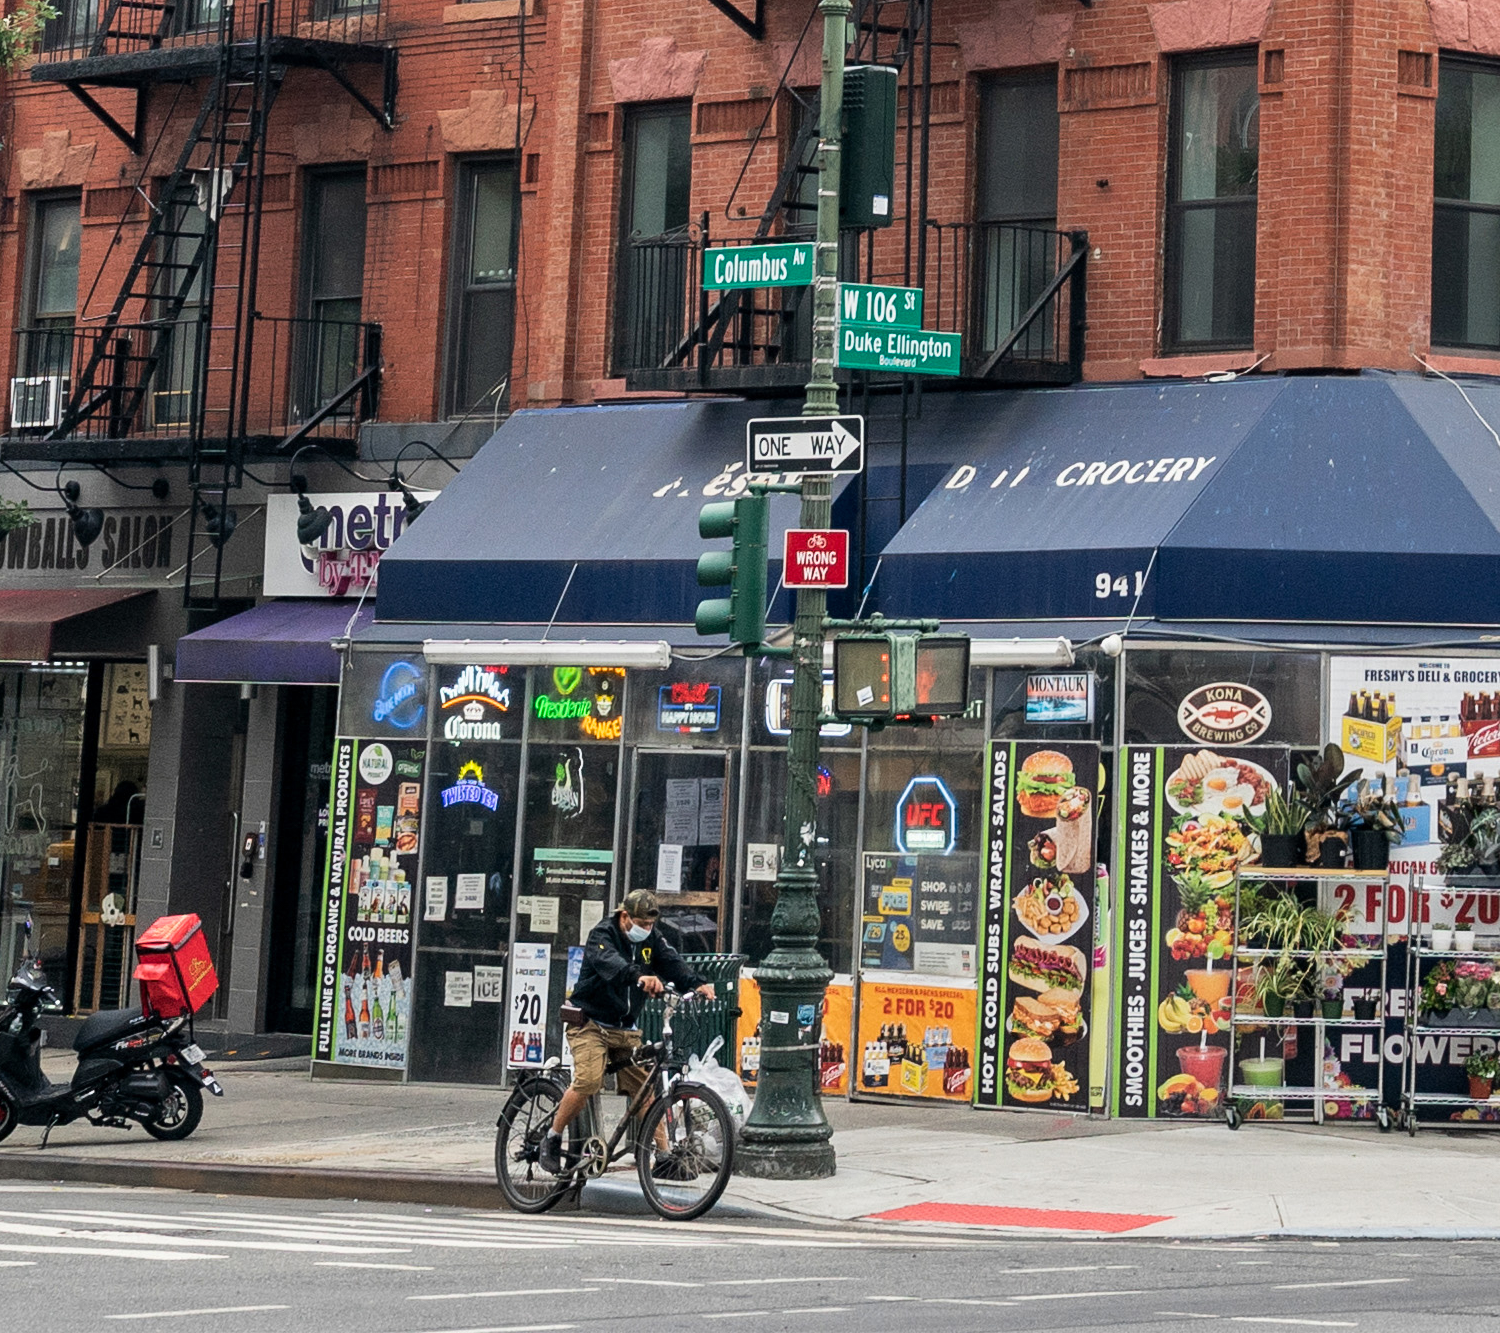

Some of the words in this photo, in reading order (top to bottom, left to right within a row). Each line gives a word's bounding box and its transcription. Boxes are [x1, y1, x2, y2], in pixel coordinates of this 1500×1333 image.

[715, 252, 788, 284] Columbus
[793, 248, 806, 266] Av
[844, 290, 859, 319] W
[866, 292, 897, 323] 106
[904, 291, 915, 310] St
[845, 331, 882, 353] Duke
[887, 334, 952, 362] Ellington
[879, 354, 917, 368] Boulevard
[759, 436, 792, 456] ONE
[811, 435, 846, 455] WAY
[101, 515, 174, 570] SALON
[796, 551, 837, 566] WRONG
[318, 550, 346, 597] by
[803, 567, 829, 581] WAY
[1095, 571, 1143, 598] 941
[1029, 676, 1084, 692] MONTAUK
[1364, 670, 1415, 683] FRESHY'S
[1417, 670, 1439, 683] DELI
[1442, 671, 1451, 683] &
[1206, 687, 1242, 702] KONA
[535, 695, 592, 719] Presidente
[661, 711, 689, 724] HAPPY
[689, 711, 716, 724] HOUR
[444, 716, 501, 740] Corona
[1192, 721, 1244, 744] BREWING
[361, 758, 389, 770] NATURAL
[1421, 747, 1455, 759] Corona
[336, 744, 350, 821] PRODUCTS
[993, 750, 1007, 826] SALADS
[1133, 752, 1151, 806] MORE
[441, 785, 480, 808] TWISTED
[480, 789, 499, 812] TEA
[906, 804, 945, 826] UFC
[1132, 813, 1148, 826] &
[330, 823, 345, 883] NATURAL
[866, 856, 887, 869] Lyca
[989, 840, 1003, 910] WRAPS
[1130, 831, 1148, 905] SHAKES
[330, 886, 341, 898] &
[921, 881, 947, 892] SHOP.
[882, 893, 909, 909] FREE
[921, 901, 953, 911] SWIPE.
[1334, 884, 1355, 921] 2
[1366, 885, 1430, 923] FOR
[325, 903, 339, 965] ORGANIC
[348, 926, 376, 942] COLD
[377, 928, 409, 944] BEERS
[921, 919, 945, 930] SAVE.
[987, 924, 1001, 973] SUBS
[1128, 919, 1146, 981] JUICES
[323, 968, 335, 986] OF
[524, 983, 528, 991] 2
[477, 983, 500, 998] ICE
[888, 987, 914, 995] MEXICAN
[939, 990, 964, 999] SPECIAL
[321, 988, 333, 1017] LINE
[515, 994, 541, 1025] $20
[883, 997, 892, 1014] 2
[896, 998, 926, 1017] FOR
[929, 999, 954, 1019] $20
[985, 978, 998, 1029] COLD
[318, 1019, 331, 1052] FULL
[984, 1034, 996, 1049] &
[339, 1047, 358, 1058] MORE
[359, 1049, 383, 1061] BRANDS
[384, 1053, 404, 1063] INSIDE
[1125, 995, 1145, 1107] SMOOTHIES
[982, 1053, 995, 1094] HOT
